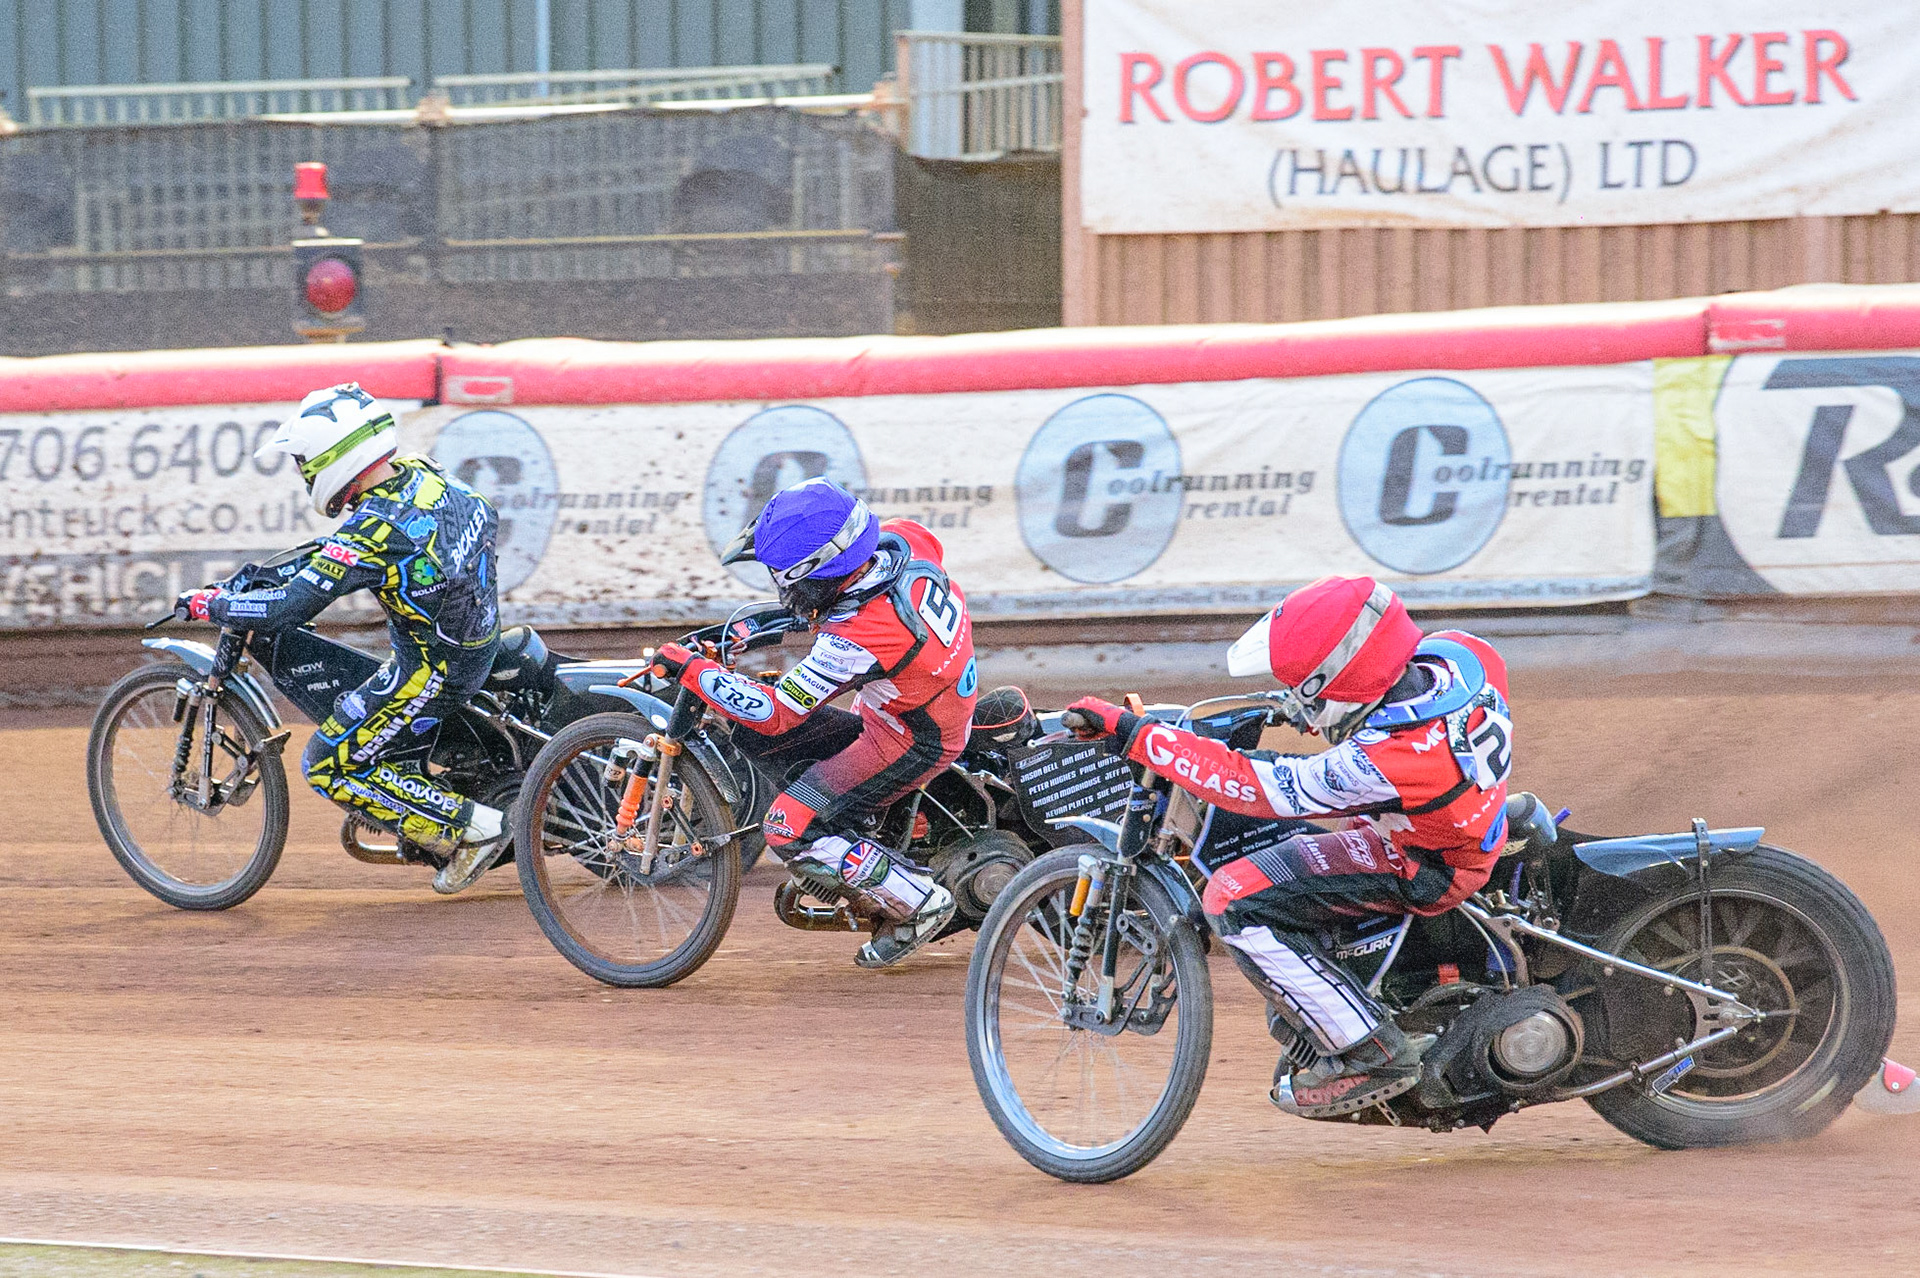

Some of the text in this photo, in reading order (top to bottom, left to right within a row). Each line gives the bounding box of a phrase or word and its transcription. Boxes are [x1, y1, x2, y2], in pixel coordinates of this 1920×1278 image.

[1118, 29, 1858, 125] ROBERT WALKER
[1267, 139, 1698, 207] (HAULAGE) LTD
[1185, 493, 1293, 519] rental
[1514, 481, 1618, 508] rental
[451, 499, 488, 574] BICKLEY
[926, 582, 958, 633] 5
[291, 661, 323, 676] NOW
[800, 673, 830, 695] MAGURA
[307, 681, 331, 692] PAUL
[711, 674, 764, 709] FRP
[1171, 742, 1250, 785] CONTEMPO
[1472, 721, 1510, 782] 2
[1020, 767, 1043, 783] JASON
[1043, 762, 1059, 774] BELL
[1062, 756, 1074, 767] IAN
[1028, 780, 1049, 795] PETER
[1050, 770, 1076, 788] HUGHES
[1079, 763, 1096, 776] PAUL
[1060, 775, 1101, 798] MOORHOUSE
[1104, 769, 1120, 781] JEFF
[1175, 758, 1257, 802] GLASS
[379, 767, 463, 812] daytona
[1068, 795, 1094, 811] PLATTS
[1096, 789, 1110, 800] SUE
